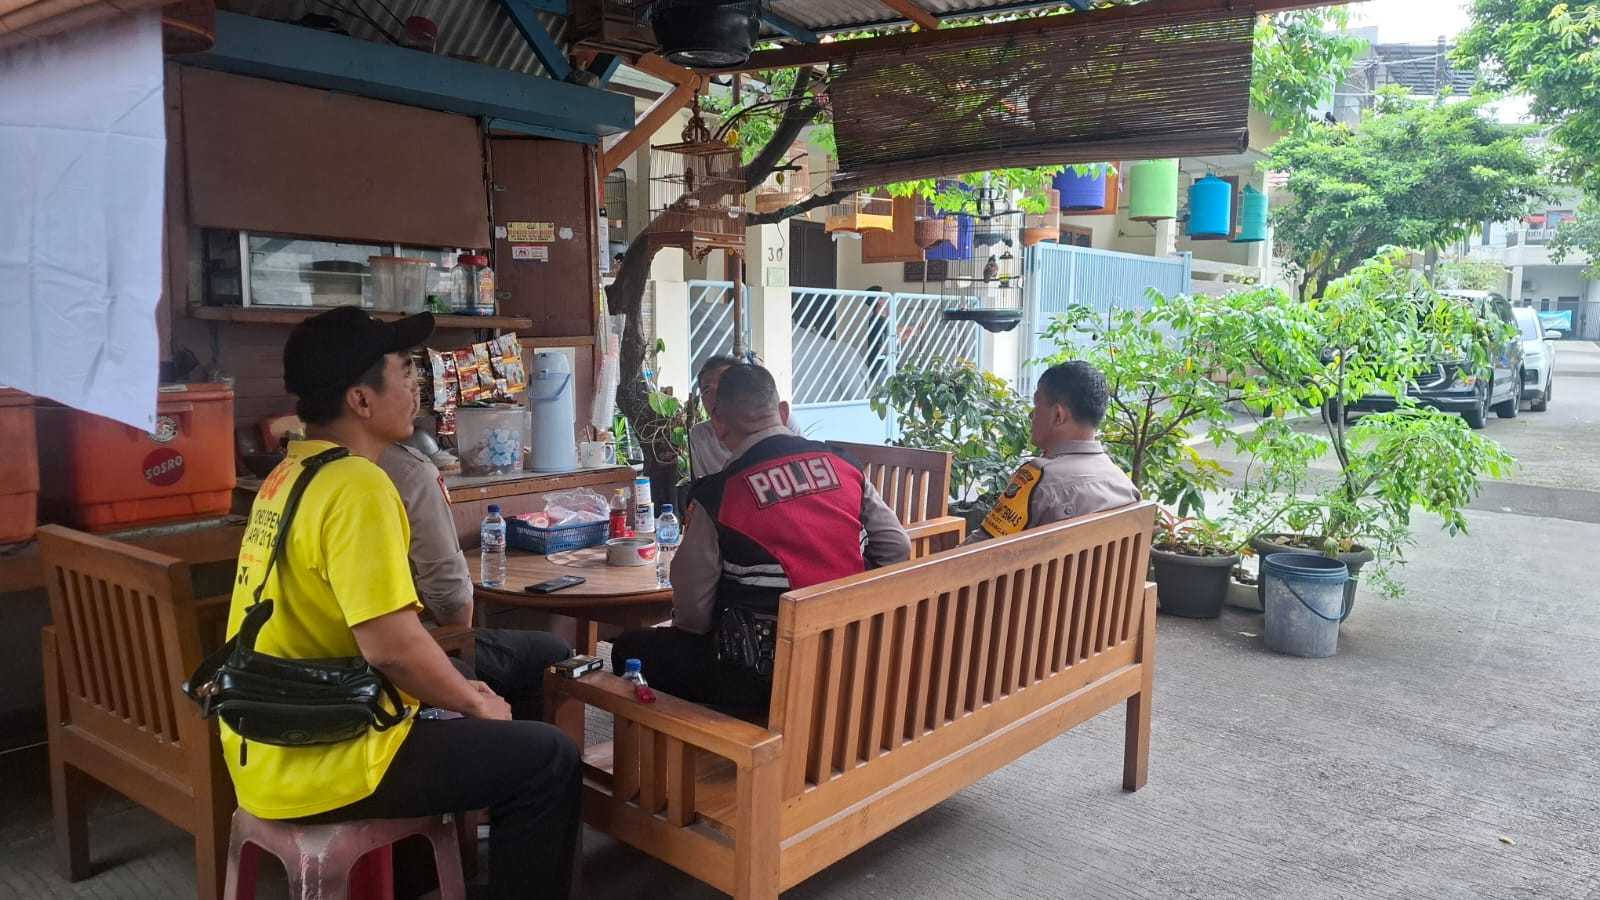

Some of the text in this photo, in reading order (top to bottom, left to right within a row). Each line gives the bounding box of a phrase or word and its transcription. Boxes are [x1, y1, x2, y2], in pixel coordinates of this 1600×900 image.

[768, 247, 783, 262] 30
[145, 455, 182, 480] SOSRO
[748, 456, 839, 504] POLISI
